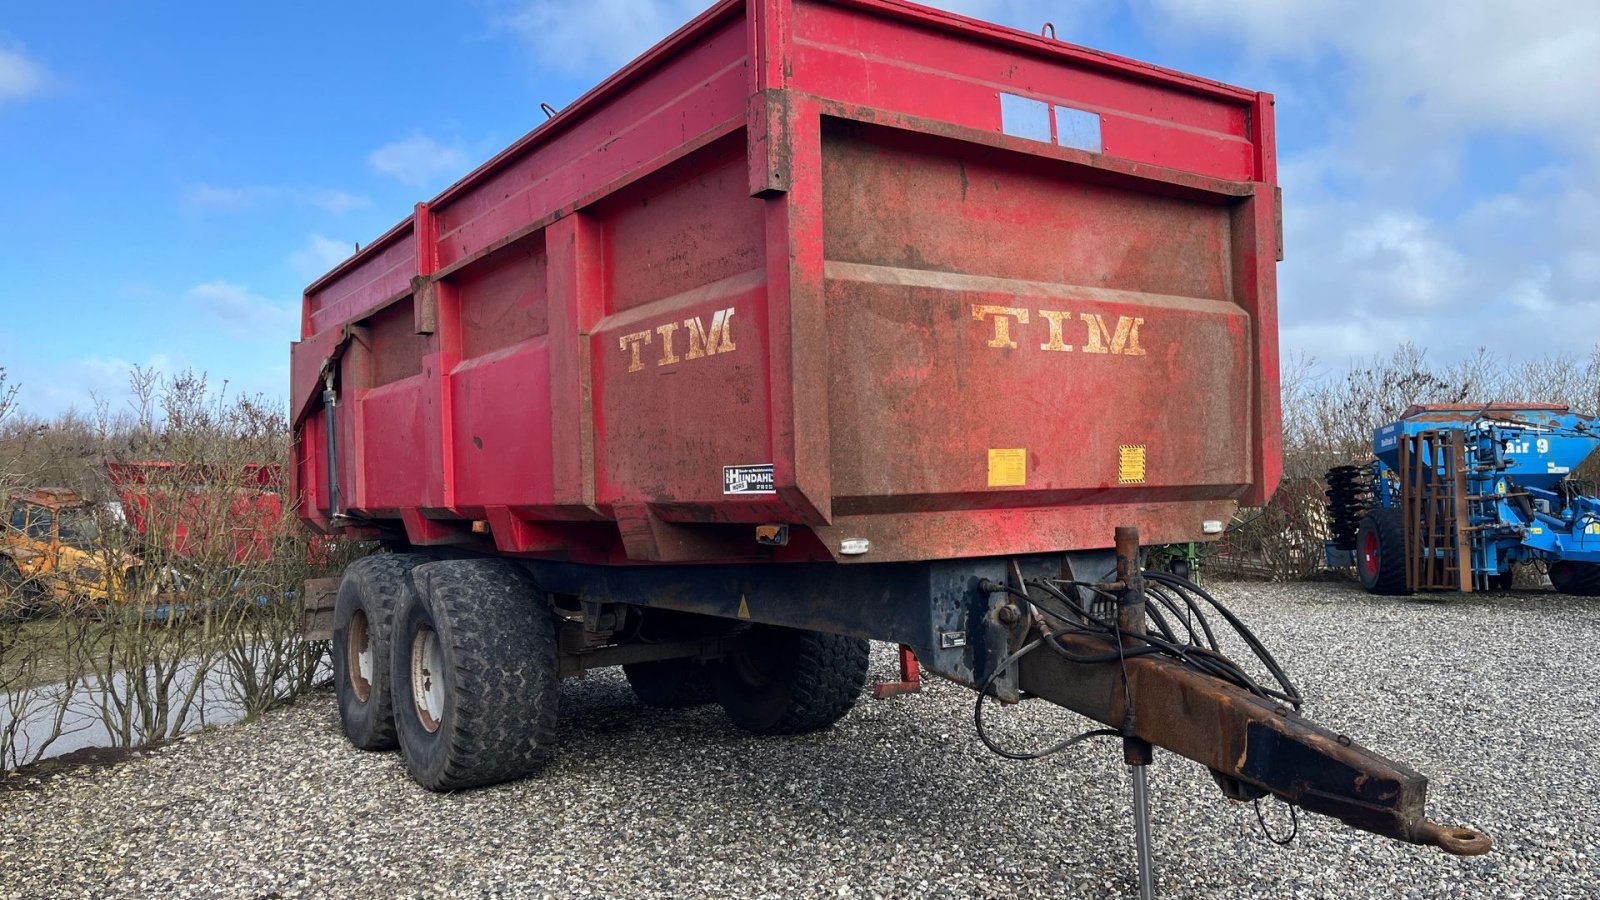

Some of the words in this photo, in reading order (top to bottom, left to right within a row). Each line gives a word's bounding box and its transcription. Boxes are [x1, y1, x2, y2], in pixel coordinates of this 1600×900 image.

[619, 307, 736, 373] TIM
[971, 304, 1146, 356] TIM
[1537, 439, 1549, 454] 9
